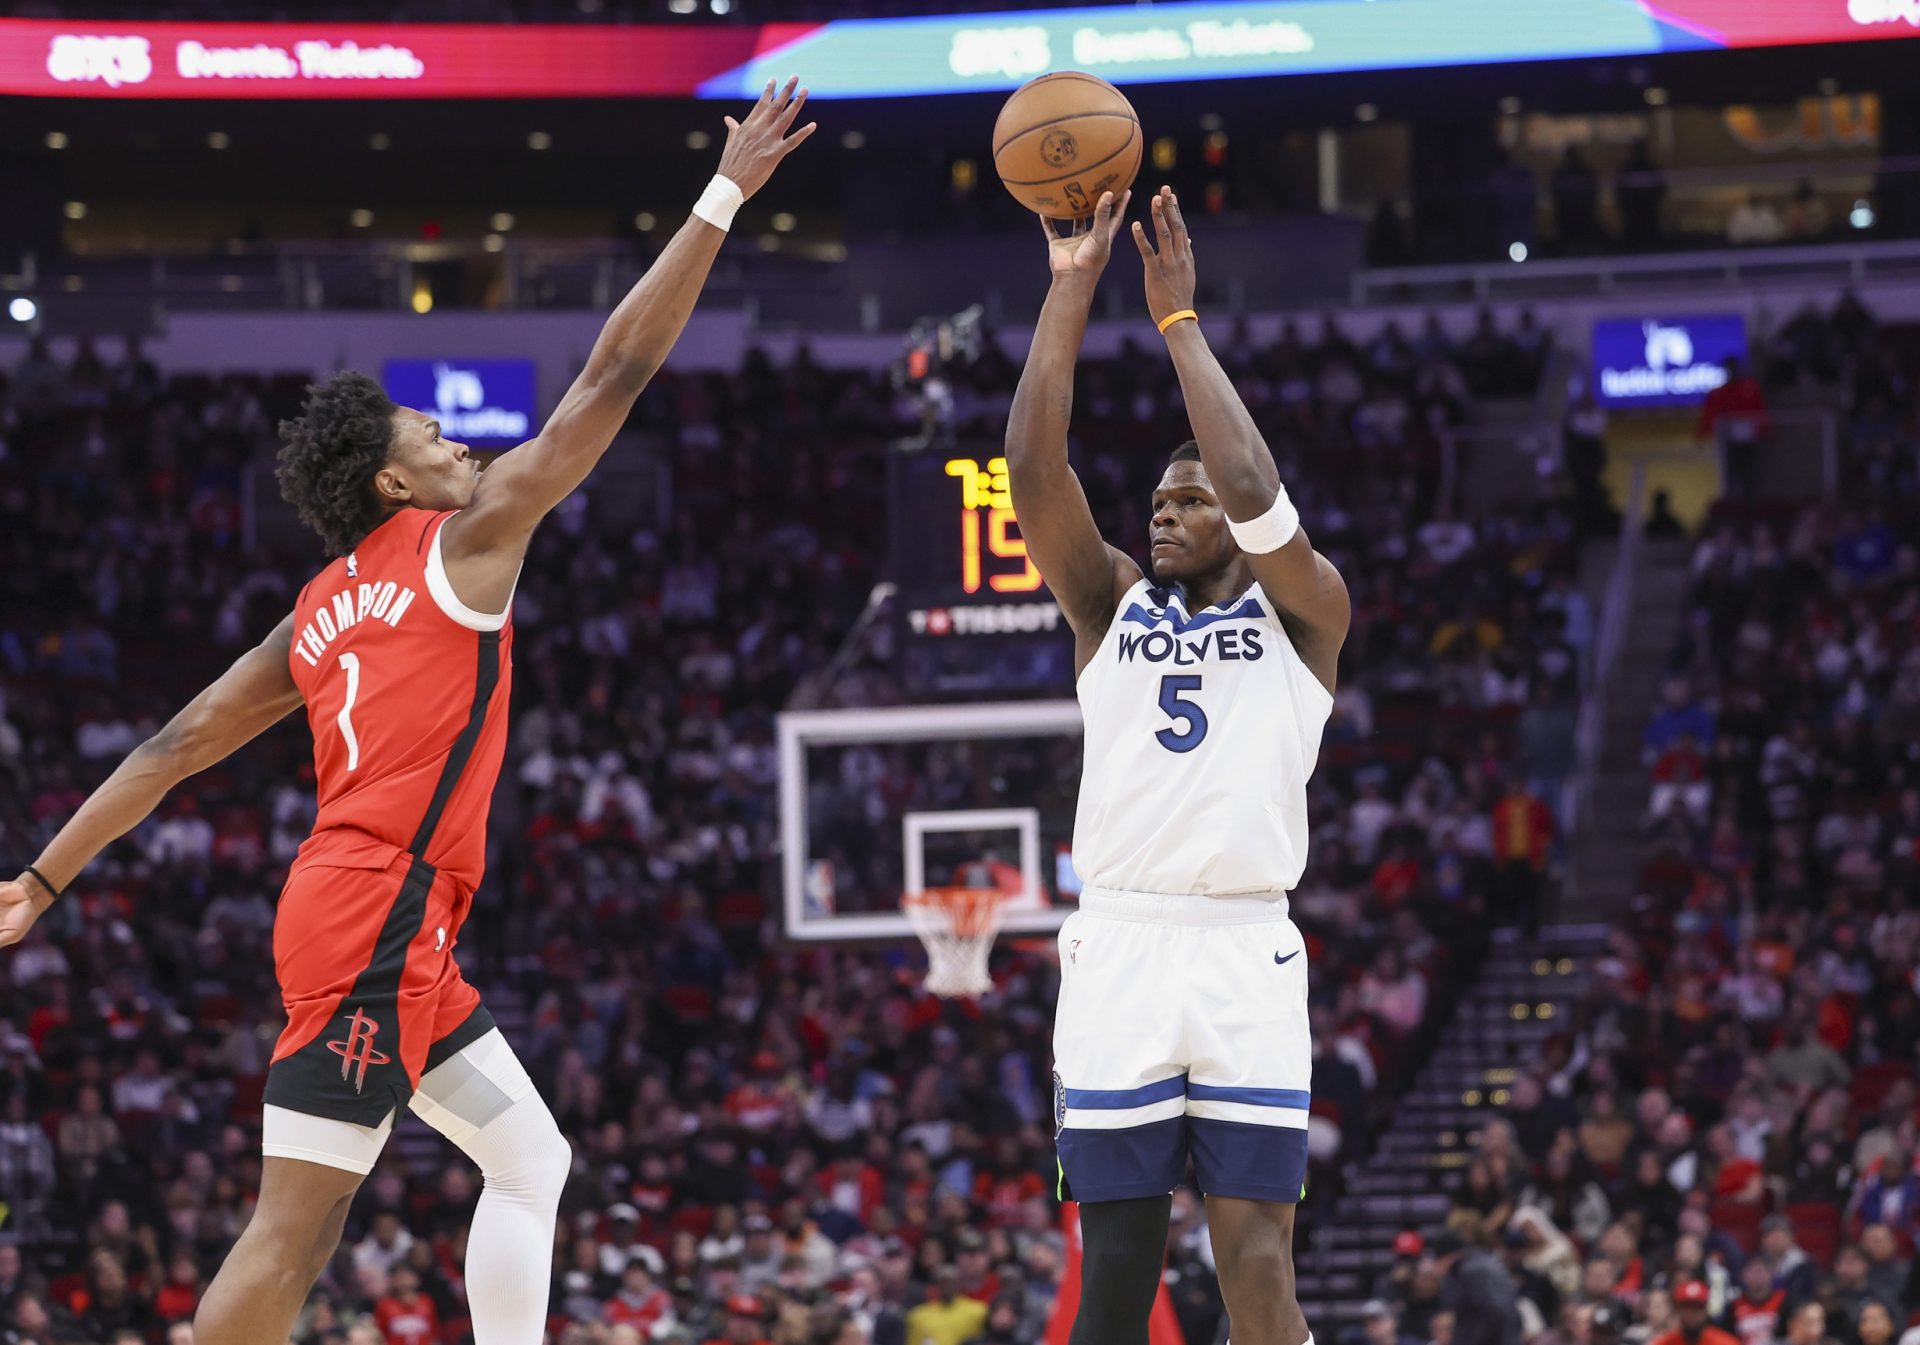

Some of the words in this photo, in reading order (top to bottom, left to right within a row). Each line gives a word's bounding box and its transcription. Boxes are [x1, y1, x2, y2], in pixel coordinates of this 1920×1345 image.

[961, 507, 1043, 594] 15
[295, 581, 416, 667] THOMPSON
[1119, 628, 1264, 666] WOLVES
[1155, 675, 1208, 753] 5
